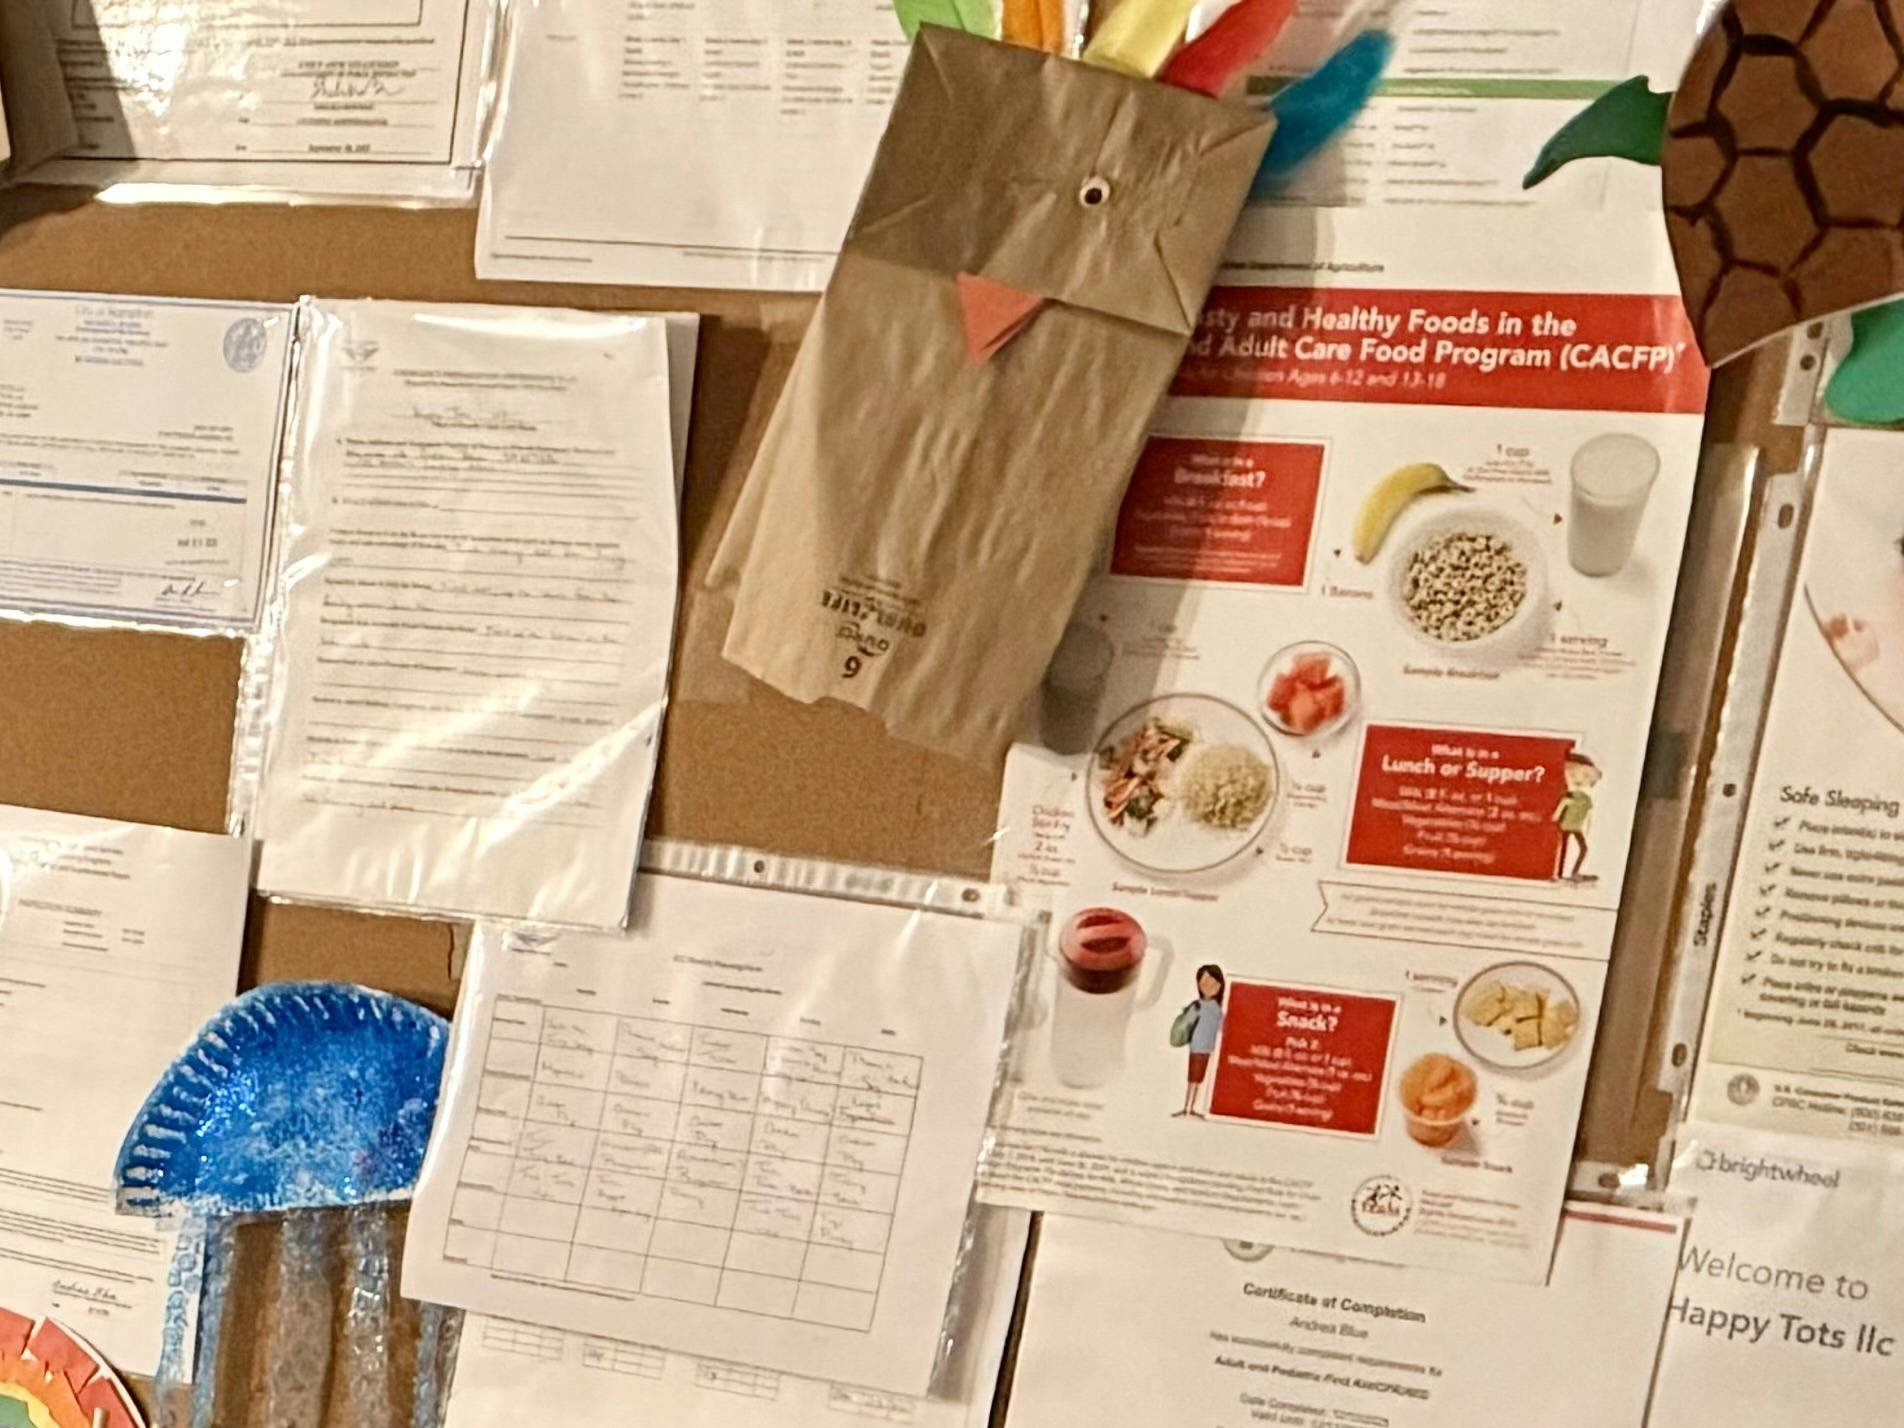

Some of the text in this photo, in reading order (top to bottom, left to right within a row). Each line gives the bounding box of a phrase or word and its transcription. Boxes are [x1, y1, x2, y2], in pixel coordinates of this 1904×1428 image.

[1249, 305, 1293, 330] and
[1303, 307, 1400, 338] Healthy
[1409, 308, 1490, 335] Foods
[1498, 310, 1523, 336] in
[1531, 310, 1577, 337] the
[1218, 335, 1288, 360] Adult
[1294, 336, 1352, 361] Care
[1359, 337, 1426, 364] Food
[1434, 342, 1552, 373] Program
[1381, 754, 1546, 786] Lunch or Supper?
[1779, 785, 1901, 818] Safe Sleeping
[1693, 881, 1717, 947] Staples
[1276, 1010, 1339, 1033] Snack?
[1718, 1152, 1841, 1189] brightwheel
[1679, 1245, 1870, 1301] Welcome to
[1242, 1281, 1427, 1324] Certificate of Completion
[1669, 1296, 1896, 1357] Happy Tots llc
